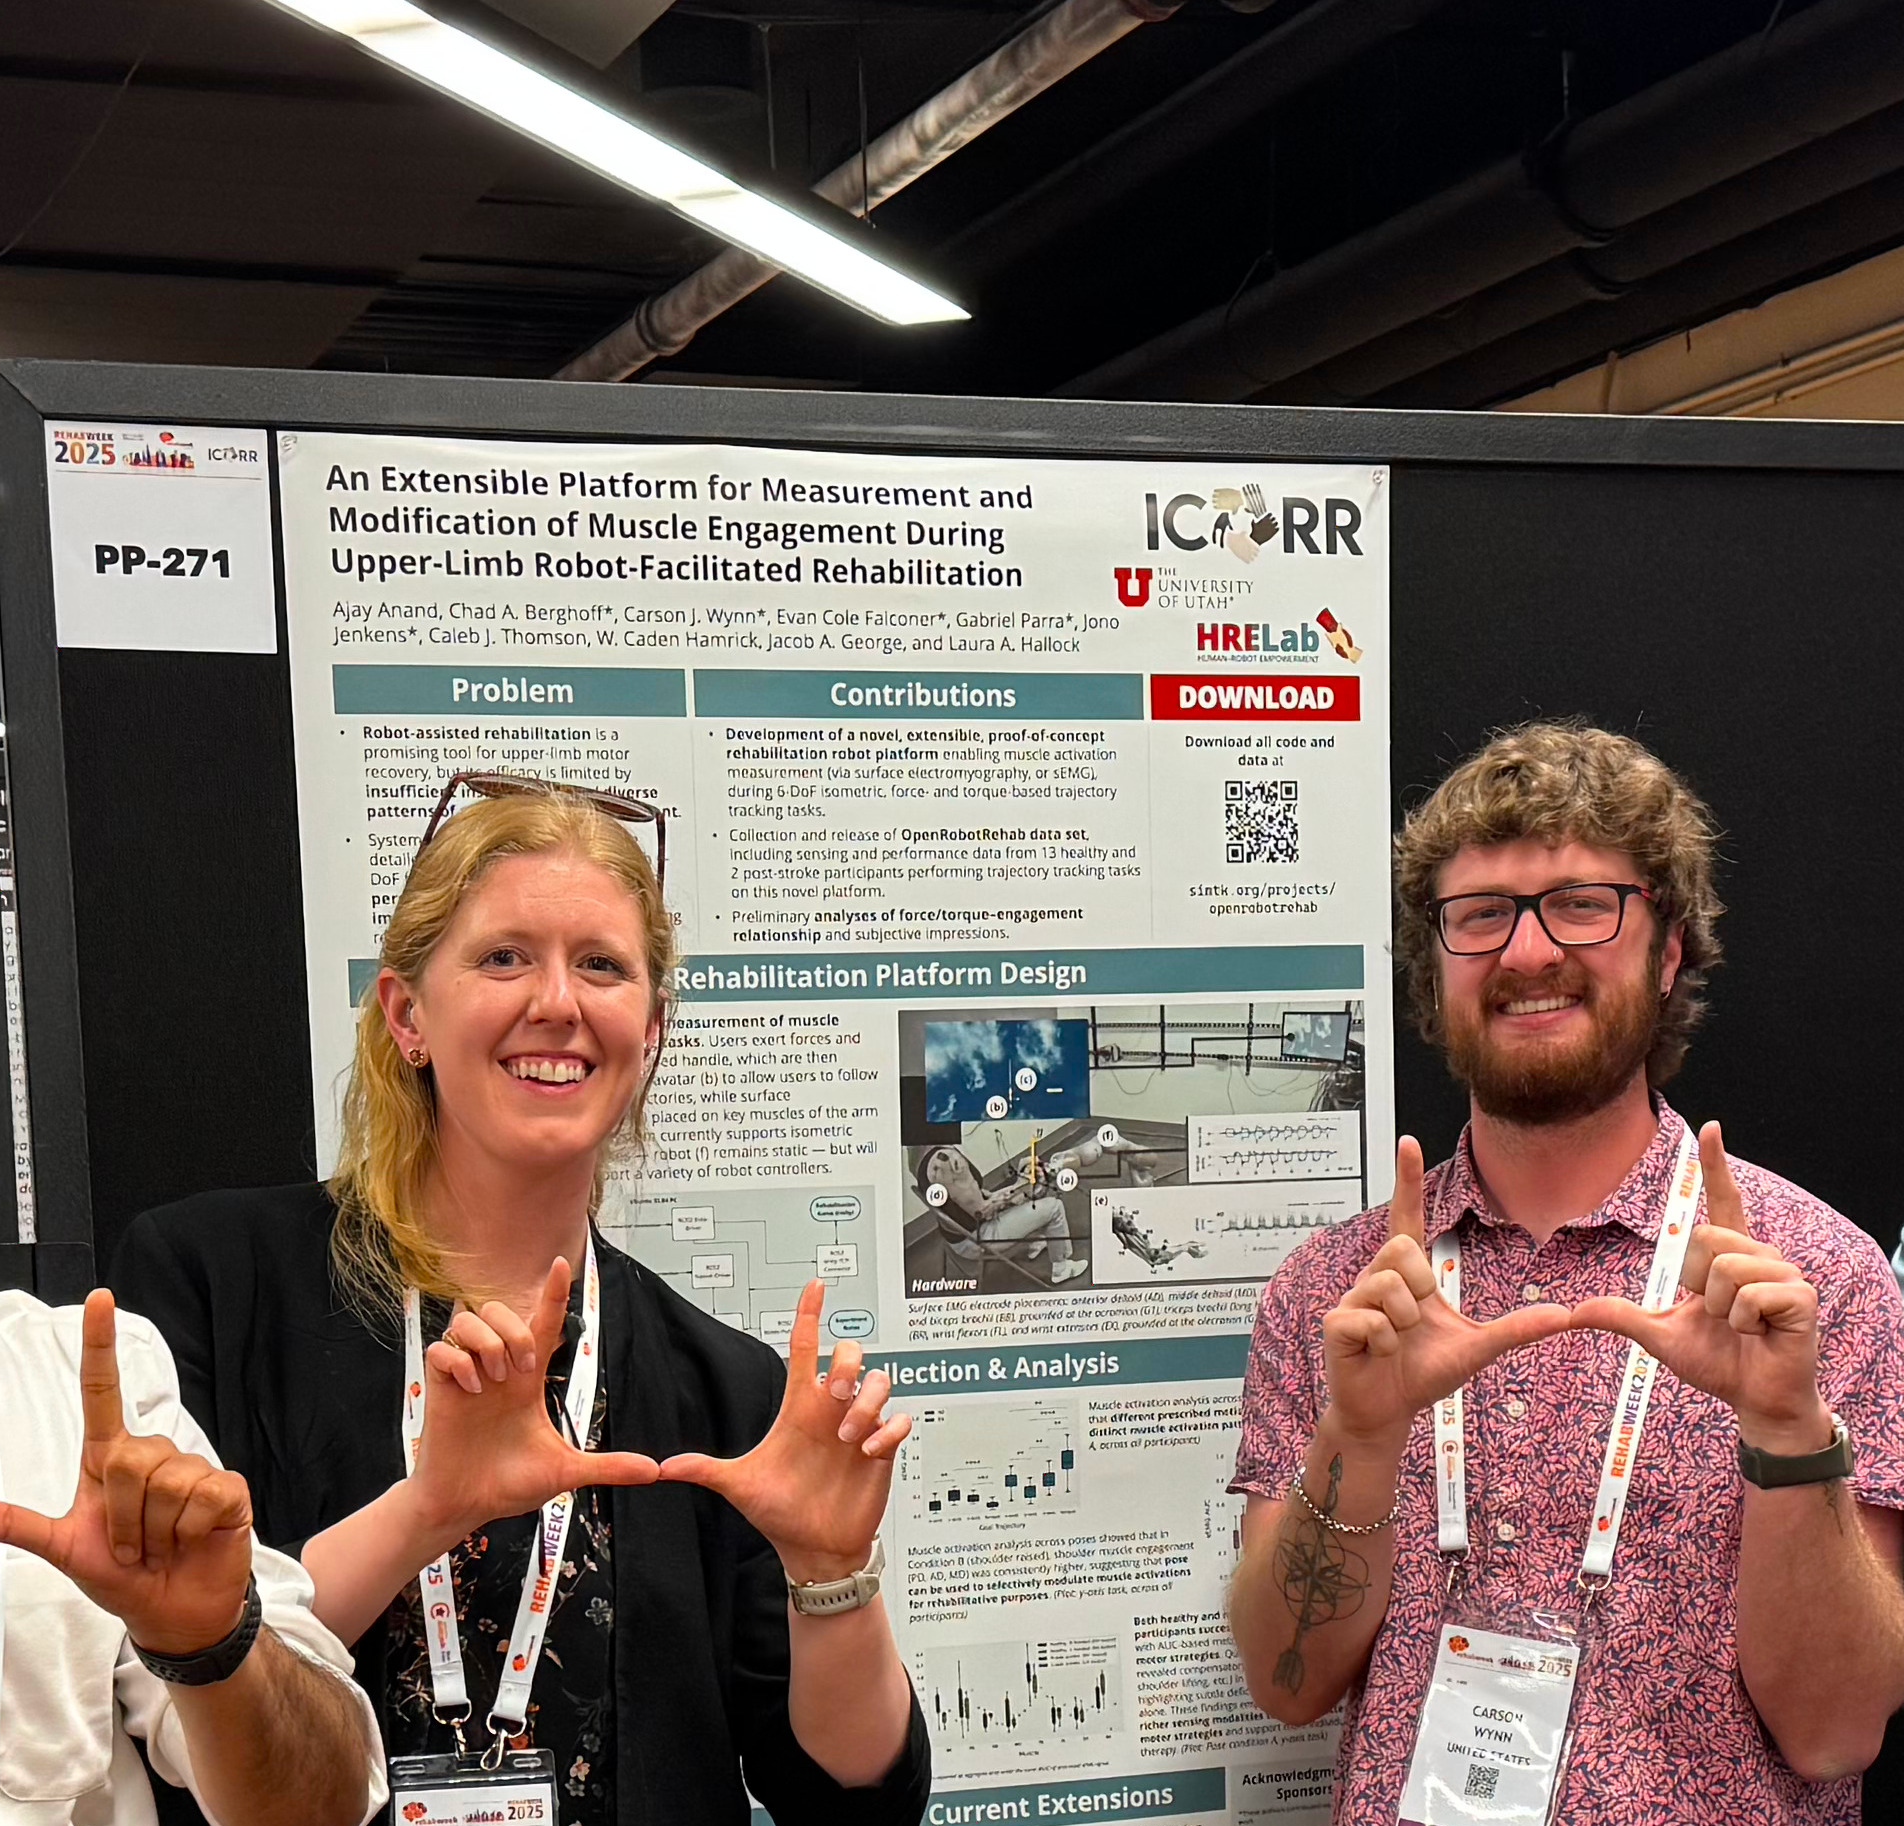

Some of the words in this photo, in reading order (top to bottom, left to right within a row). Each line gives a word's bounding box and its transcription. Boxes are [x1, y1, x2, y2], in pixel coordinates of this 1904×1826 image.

[54, 441, 116, 465] 2025
[326, 464, 369, 491] An
[381, 466, 548, 495] Extensible
[559, 471, 697, 499] Platform
[707, 474, 751, 500] for
[762, 477, 970, 507] Measurement
[980, 484, 1032, 508] and
[329, 505, 535, 536] Modification
[547, 510, 579, 537] of
[589, 512, 697, 539] Muscle
[708, 515, 896, 550] Engagement
[907, 521, 1004, 554] During
[95, 544, 230, 578] PP-271
[332, 547, 523, 582] Upper-Limb
[535, 551, 801, 582] Robot-Facilitated
[813, 557, 1021, 586] Rehabilitation
[1158, 567, 1176, 576] THE
[1114, 567, 1153, 607] U
[1158, 580, 1254, 594] UNIVERSITY
[1158, 596, 1179, 608] OF
[1197, 623, 1319, 652] HRELab
[452, 676, 573, 703] Problem
[831, 681, 1016, 707] Contributions
[1179, 685, 1335, 709] DOWNLOAD
[1185, 735, 1251, 747] Download
[1255, 735, 1271, 747] all
[1276, 736, 1306, 747] code
[1310, 735, 1334, 747] and
[1238, 754, 1267, 765] data
[1272, 755, 1283, 766] at
[1209, 901, 1318, 916] openrobotrehab
[673, 965, 867, 992] Rehabilitation
[876, 961, 991, 987] Platform
[1000, 959, 1086, 987] Design
[912, 1274, 978, 1292] Hardware
[887, 1360, 980, 1387] llection
[987, 1357, 1007, 1379] &
[1013, 1351, 1119, 1381] Analysis
[1538, 1659, 1572, 1677] 2025
[1472, 1705, 1523, 1723] CARSON
[1474, 1726, 1513, 1743] WYNN
[507, 1804, 544, 1821] 2025
[928, 1797, 1030, 1825] Current
[1037, 1786, 1172, 1815] Extensions
